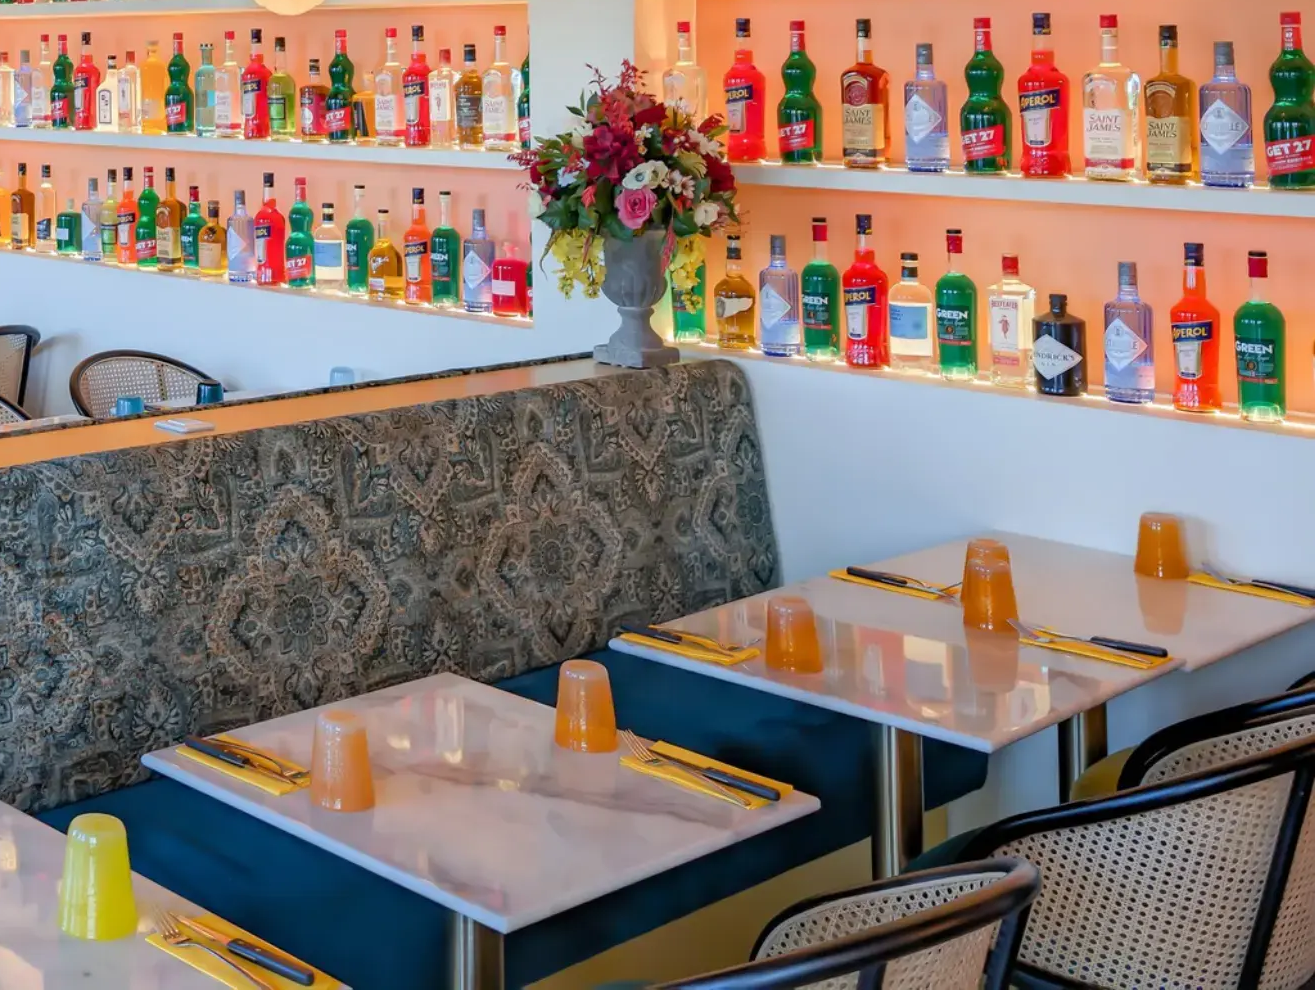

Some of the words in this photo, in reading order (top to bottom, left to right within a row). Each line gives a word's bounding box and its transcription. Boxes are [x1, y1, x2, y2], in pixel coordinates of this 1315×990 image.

[845, 109, 871, 118] SAINT
[1088, 114, 1121, 124] SAINT
[1086, 123, 1122, 132] JAMES
[1148, 121, 1176, 131] SAINT
[979, 129, 995, 141] 27
[1146, 129, 1178, 138] JAMES
[1267, 143, 1291, 157] GET
[1292, 139, 1312, 153] 27
[1236, 340, 1273, 354] GREEN
